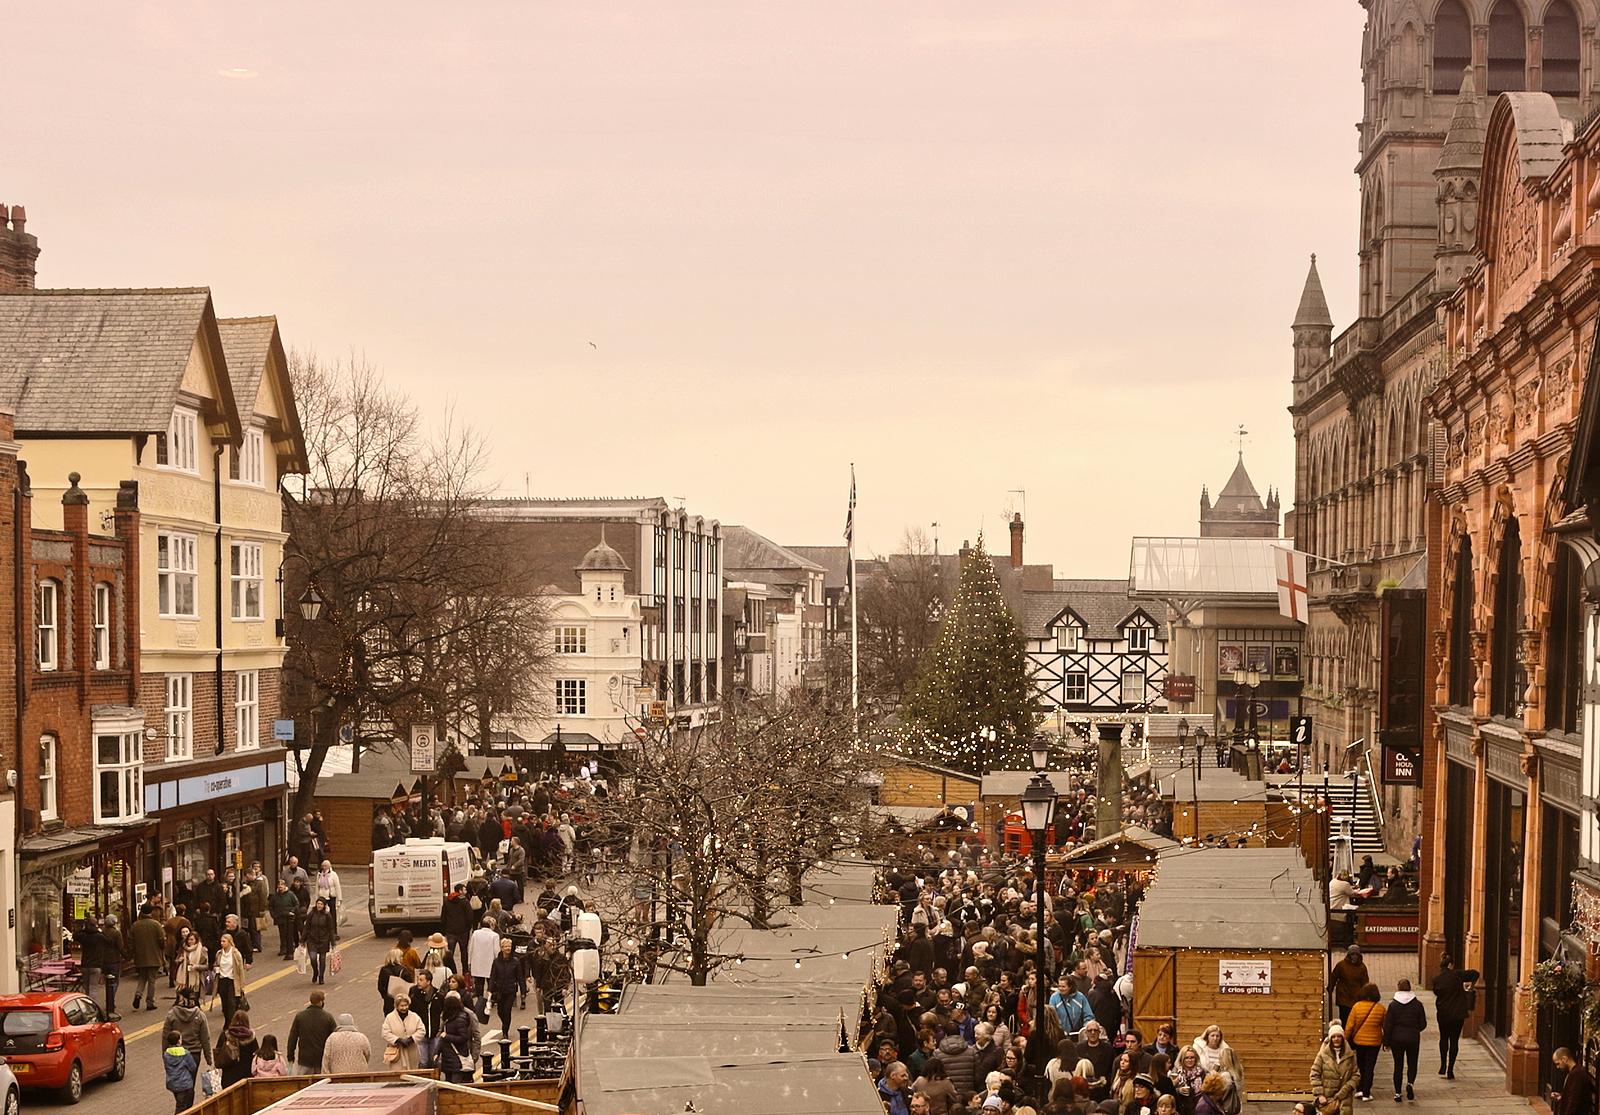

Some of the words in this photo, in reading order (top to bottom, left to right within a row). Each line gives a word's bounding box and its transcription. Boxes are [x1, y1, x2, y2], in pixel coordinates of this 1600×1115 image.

[1395, 768, 1412, 776] INN
[413, 860, 437, 868] MEATS
[1246, 986, 1262, 994] gifts
[955, 1002, 965, 1010] 37
